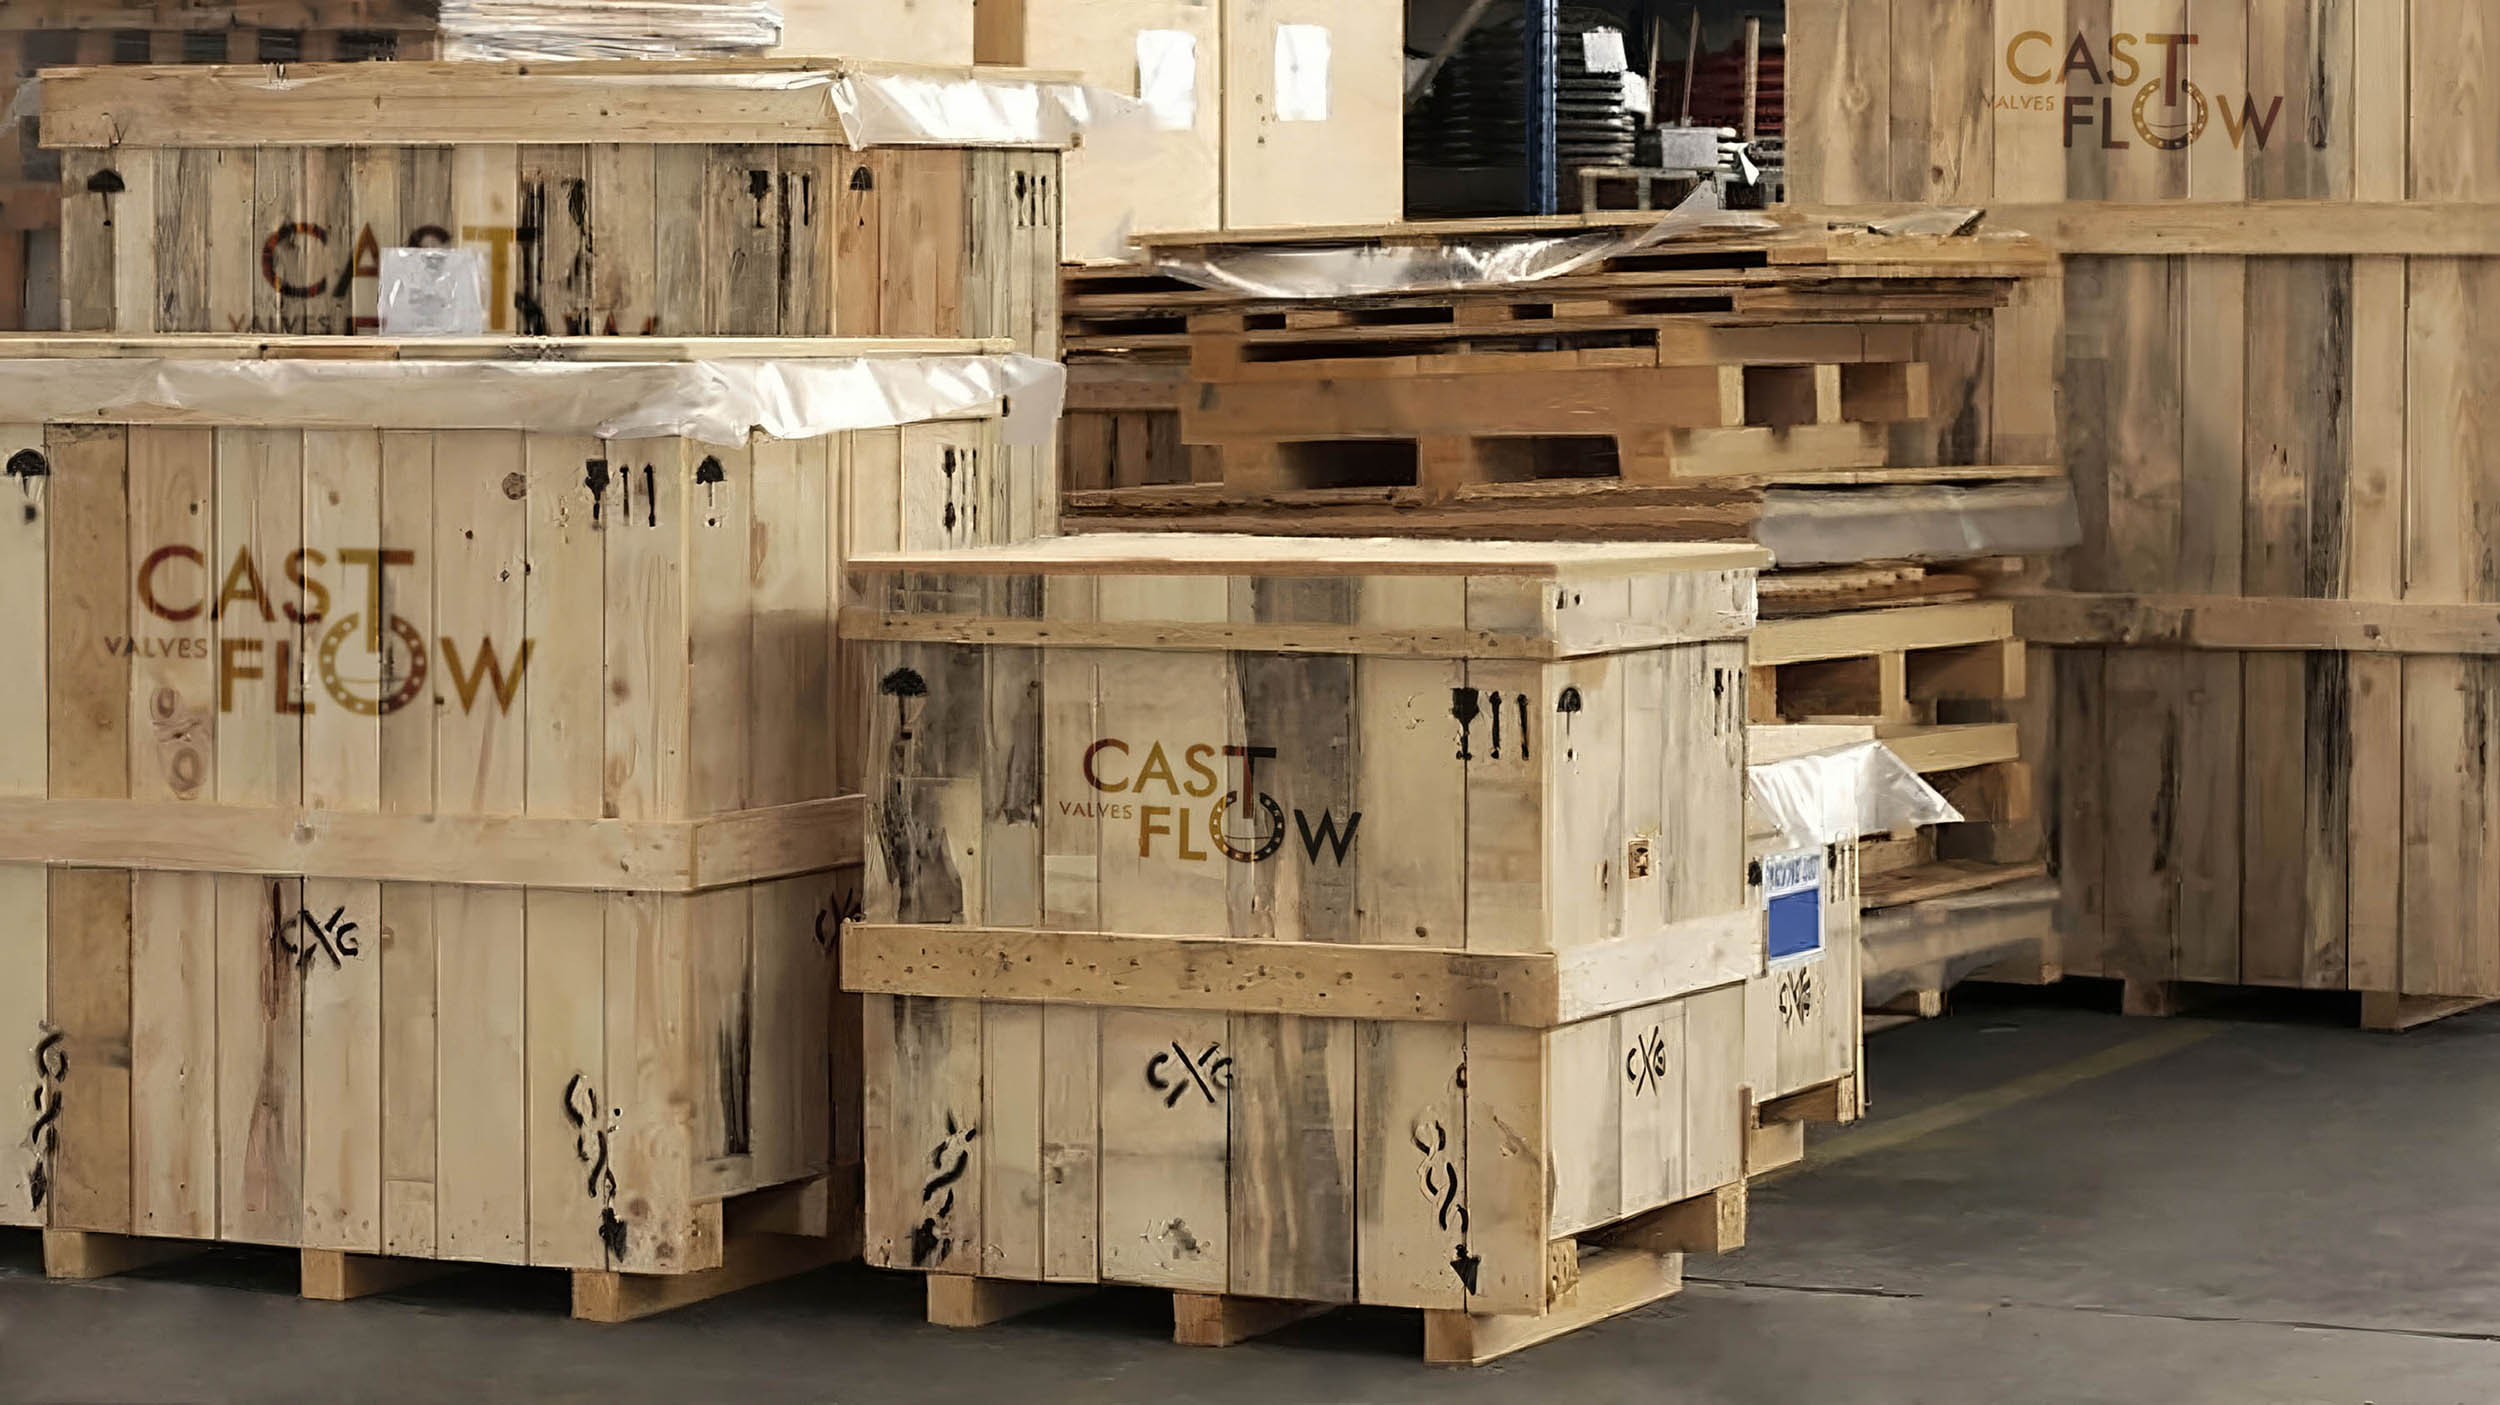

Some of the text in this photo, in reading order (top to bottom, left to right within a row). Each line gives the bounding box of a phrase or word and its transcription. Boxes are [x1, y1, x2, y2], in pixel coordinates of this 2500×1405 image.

[1979, 92, 2055, 111] VALVES
[2006, 30, 2198, 106] CAST
[2063, 78, 2283, 151] FLOW
[137, 544, 415, 654] CAST
[104, 636, 208, 659] VALVES
[220, 612, 536, 718] FLOW
[1059, 800, 1133, 820] VALVES
[1083, 738, 1277, 819] CAST
[1138, 790, 1362, 867] FLOW
